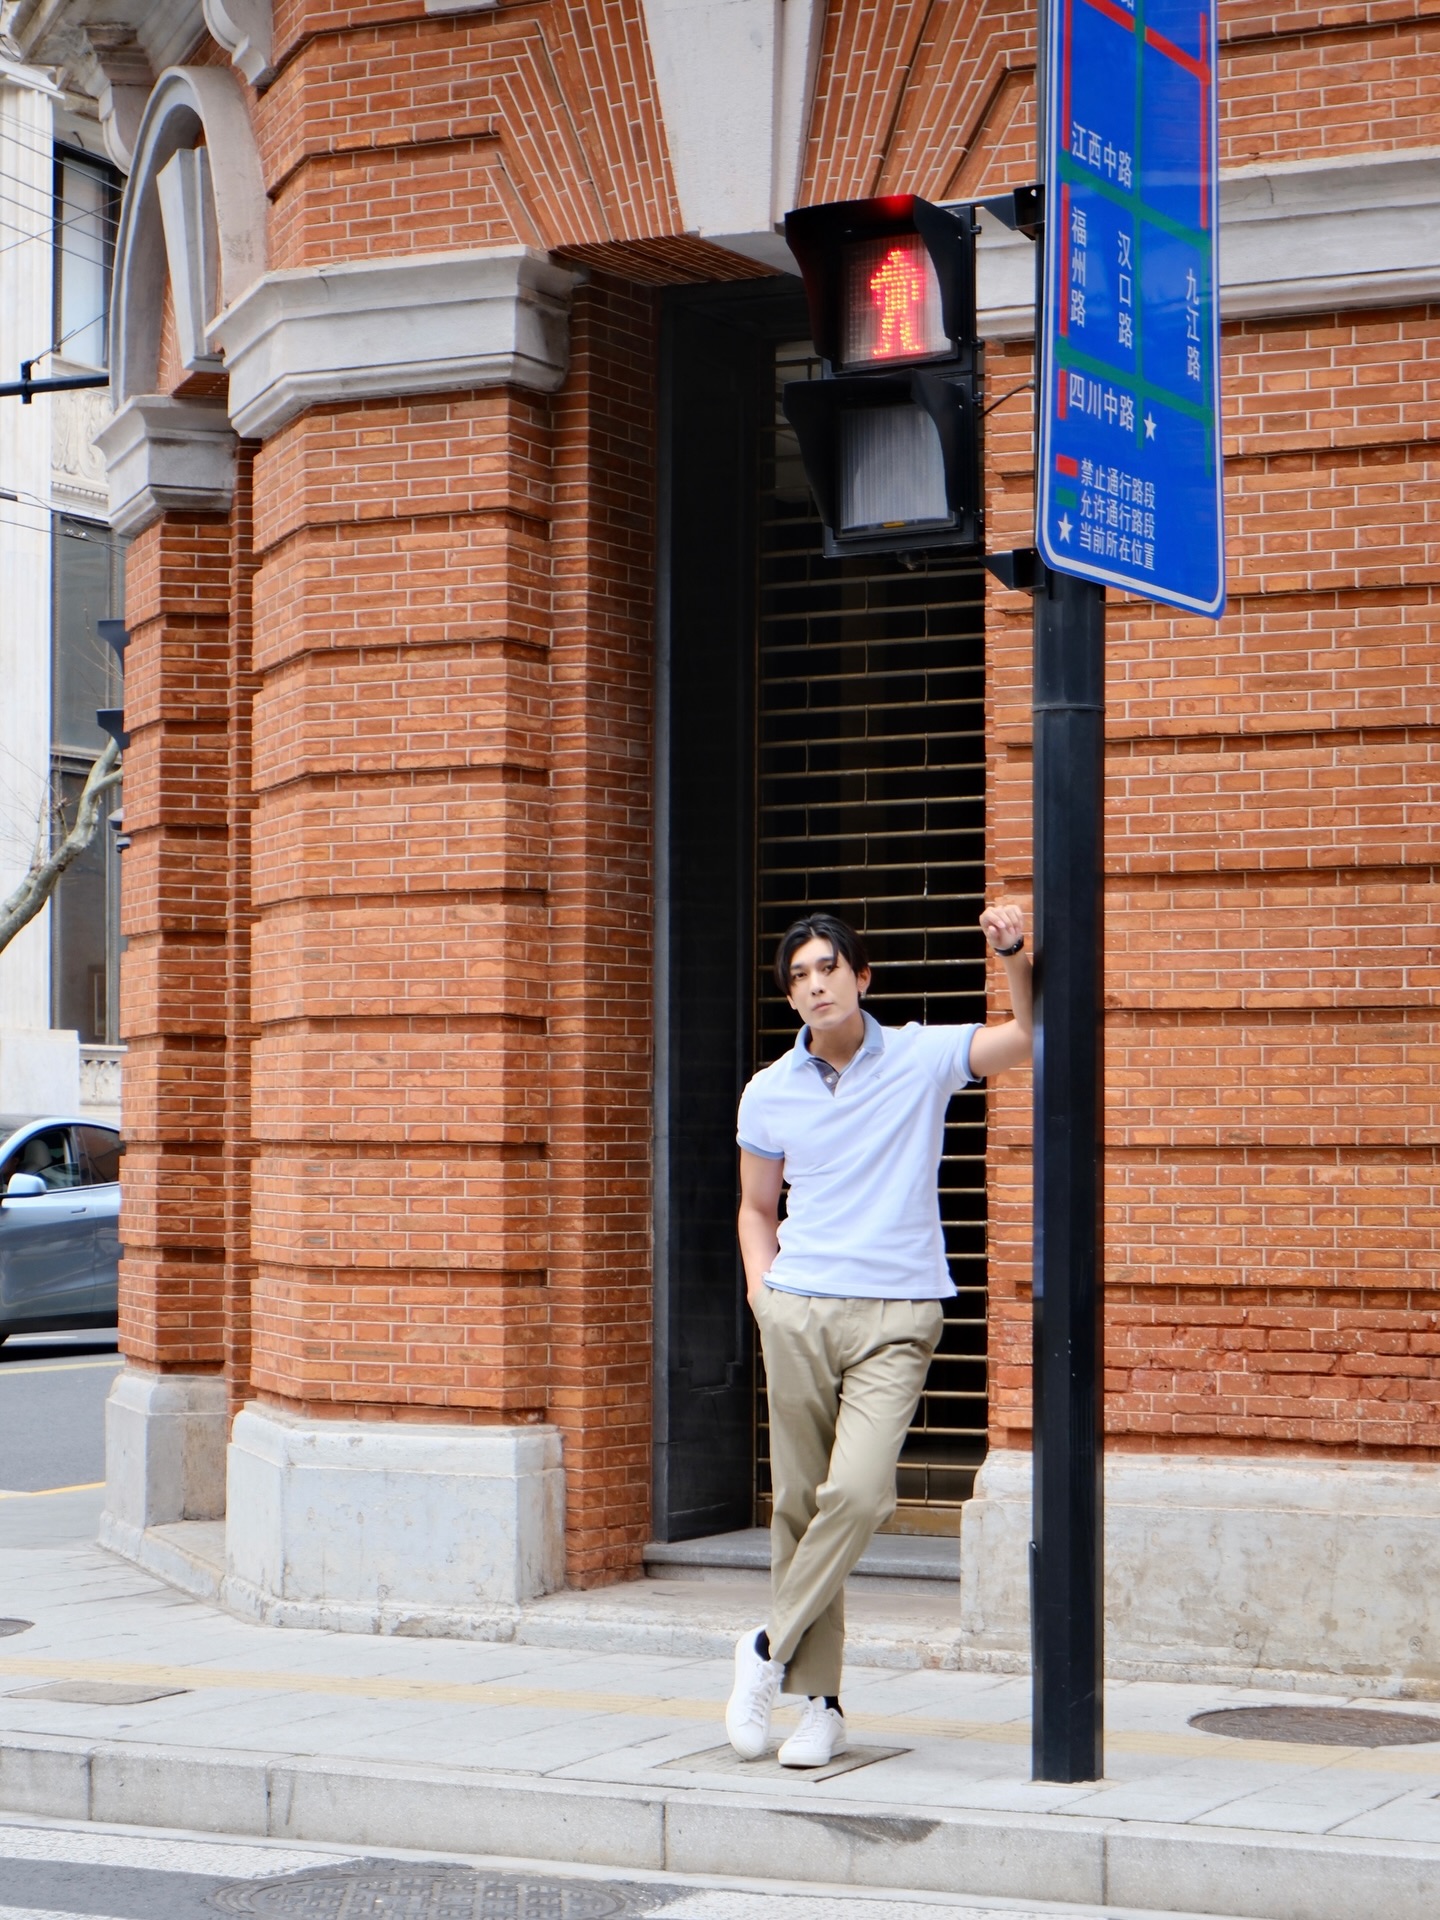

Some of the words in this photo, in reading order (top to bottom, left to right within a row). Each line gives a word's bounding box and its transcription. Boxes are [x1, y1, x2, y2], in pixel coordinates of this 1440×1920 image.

[1072, 121, 1132, 189] 江西中路
[1070, 206, 1087, 328] 福州路
[1117, 231, 1132, 350] 汉口路
[1186, 268, 1200, 381] 九江路
[1069, 372, 1135, 434] 四川中路
[1079, 489, 1156, 541] 允许通行路段
[1080, 457, 1156, 511] 禁止通行路段
[1079, 520, 1156, 571] 当前所在位置
